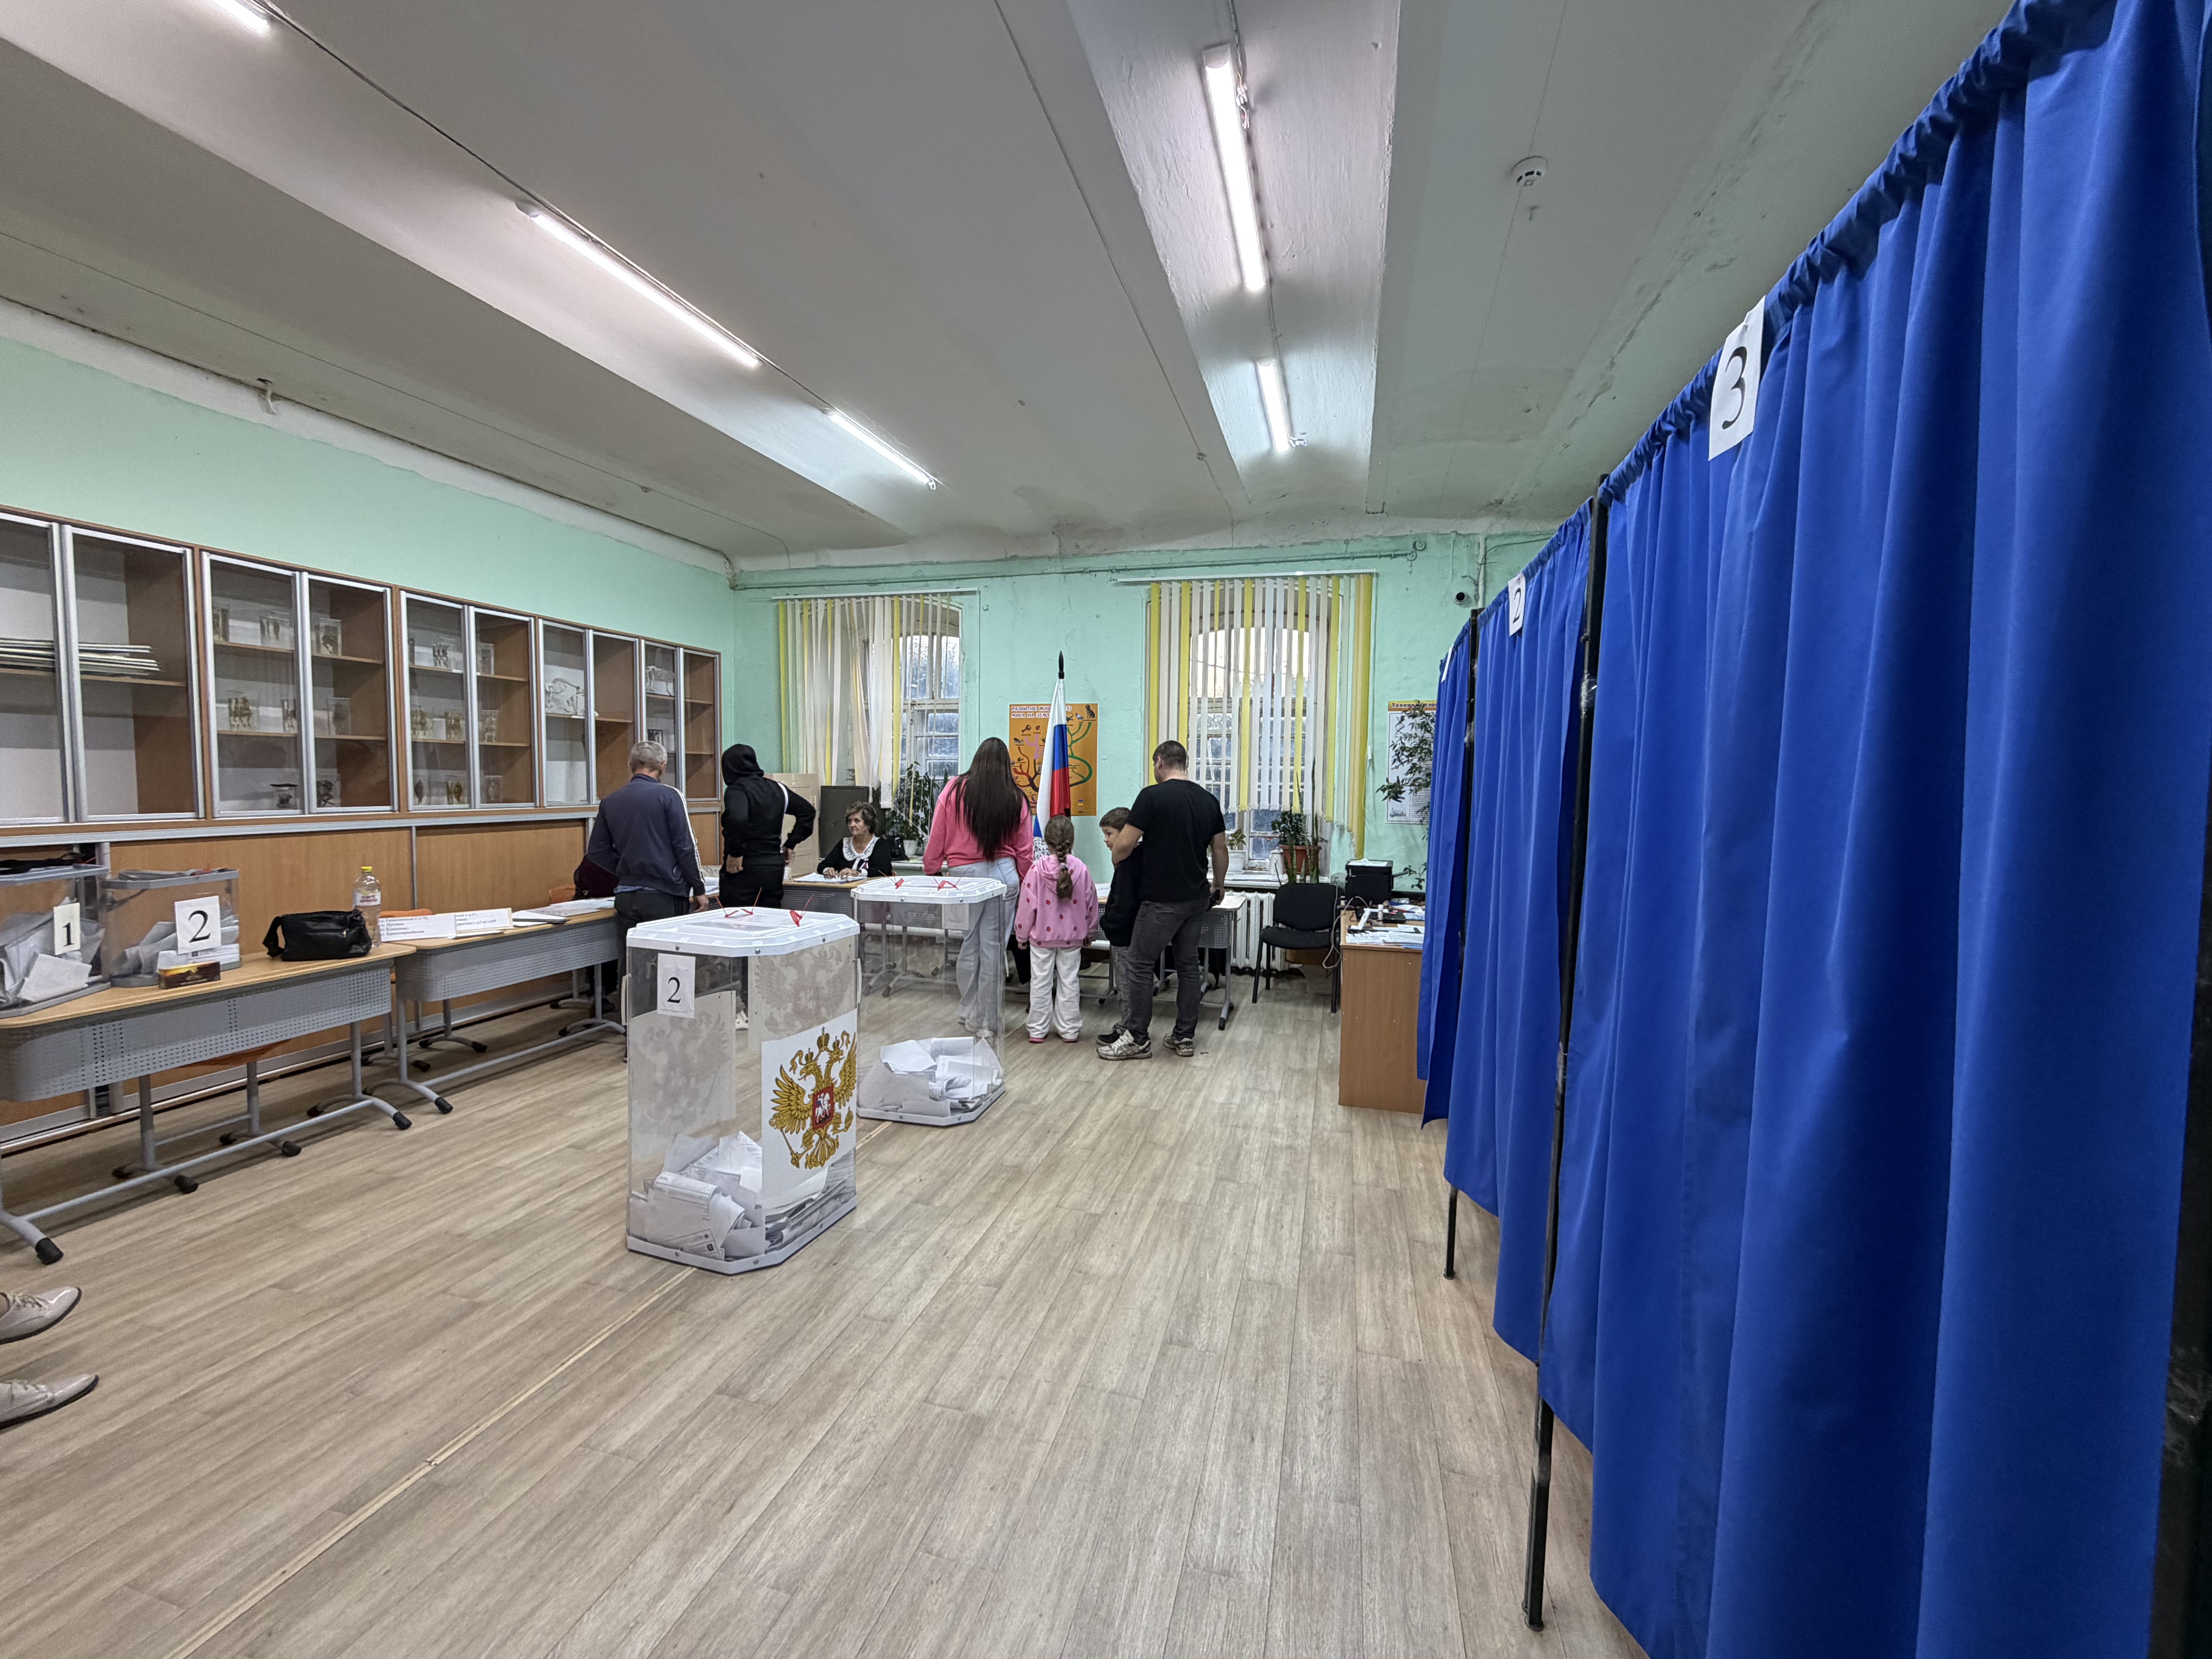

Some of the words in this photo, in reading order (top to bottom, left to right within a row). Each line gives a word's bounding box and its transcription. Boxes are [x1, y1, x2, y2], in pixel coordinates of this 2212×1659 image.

[1722, 346, 1747, 429] 3
[1512, 587, 1521, 624] 2
[63, 922, 74, 947] 1
[188, 910, 211, 943] 2
[667, 977, 681, 1003] 2
